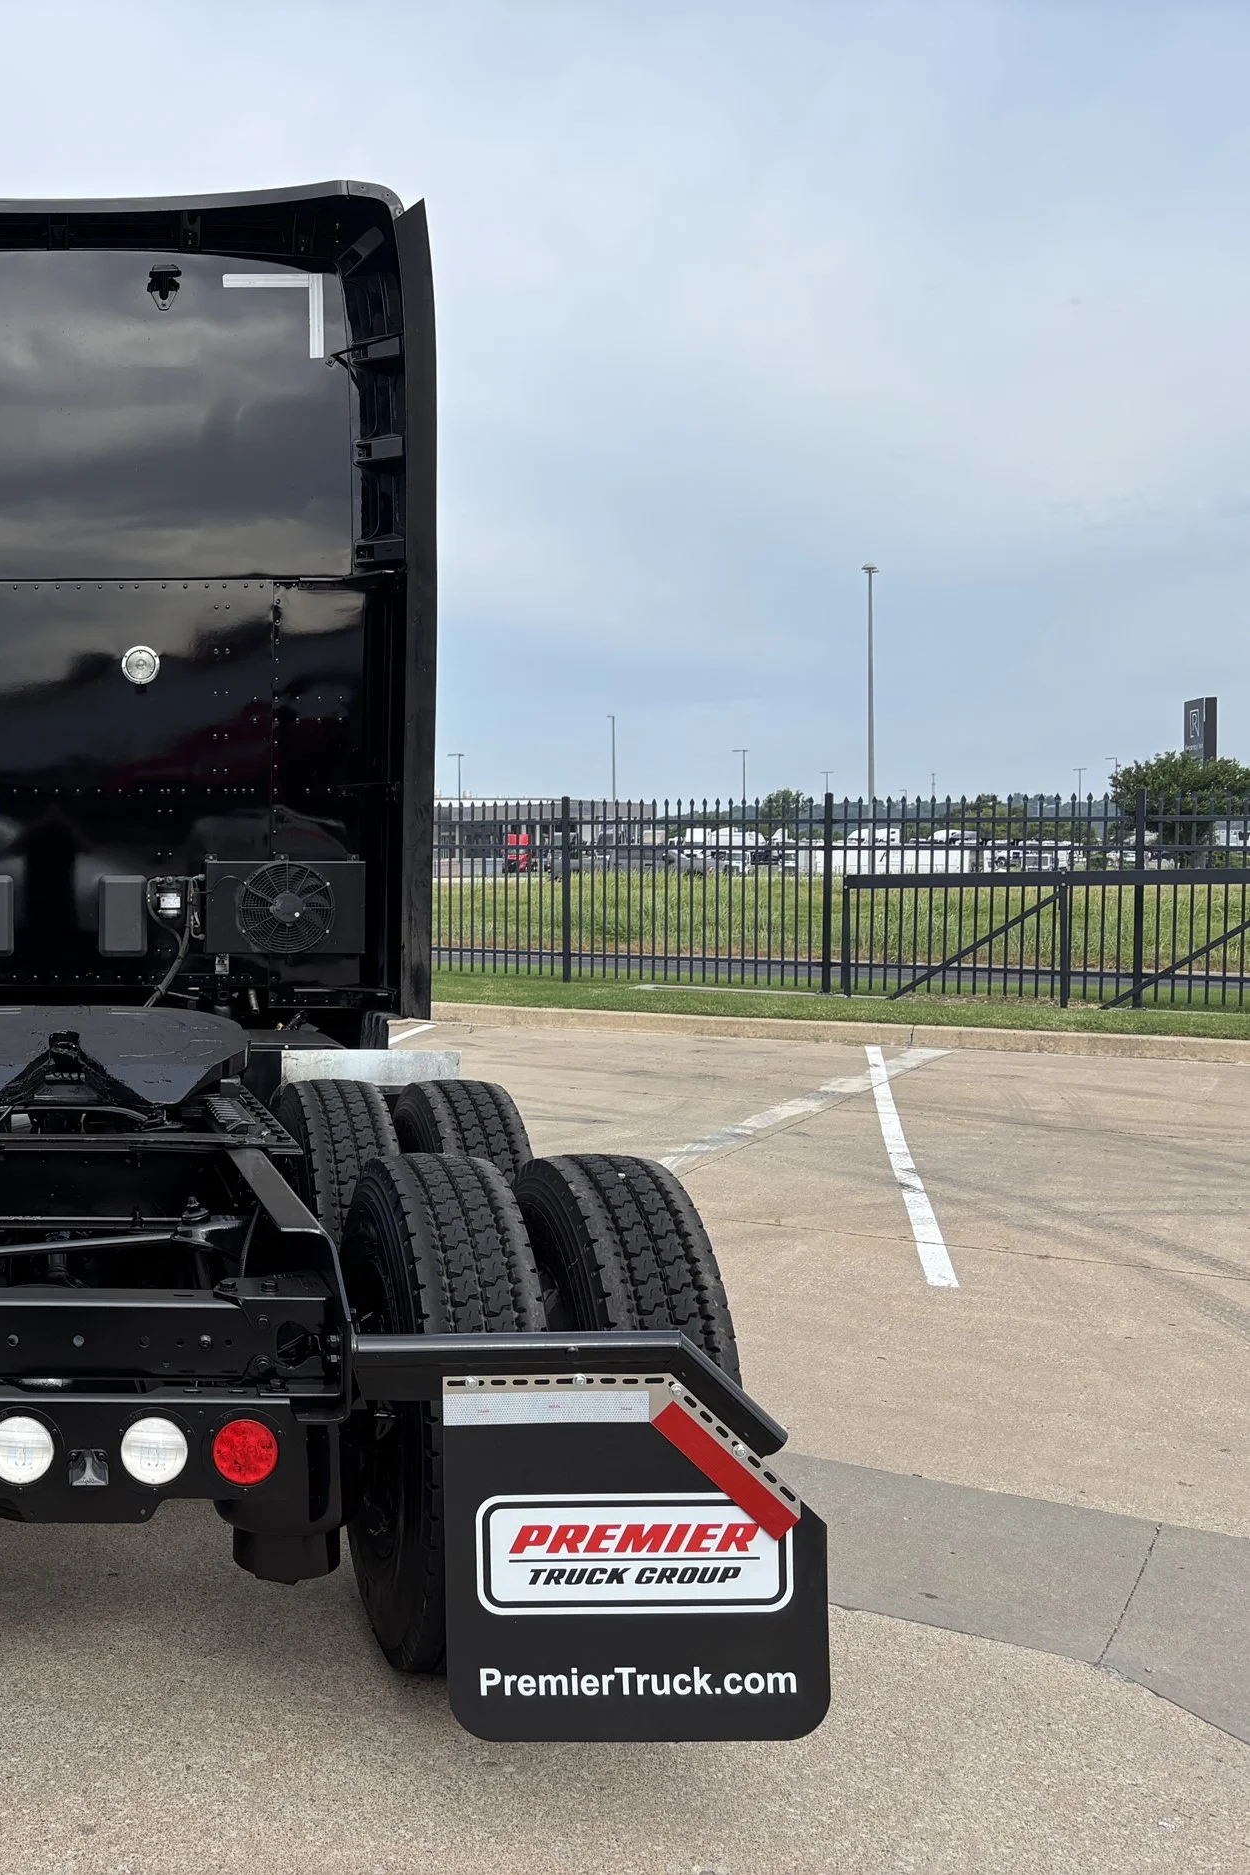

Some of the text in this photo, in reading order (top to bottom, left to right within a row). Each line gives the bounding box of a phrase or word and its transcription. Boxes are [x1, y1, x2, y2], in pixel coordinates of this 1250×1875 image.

[509, 1523, 760, 1554] PREMIER
[528, 1566, 742, 1585] TRUCK GROUP
[479, 1667, 797, 1696] PremierTruck.com
